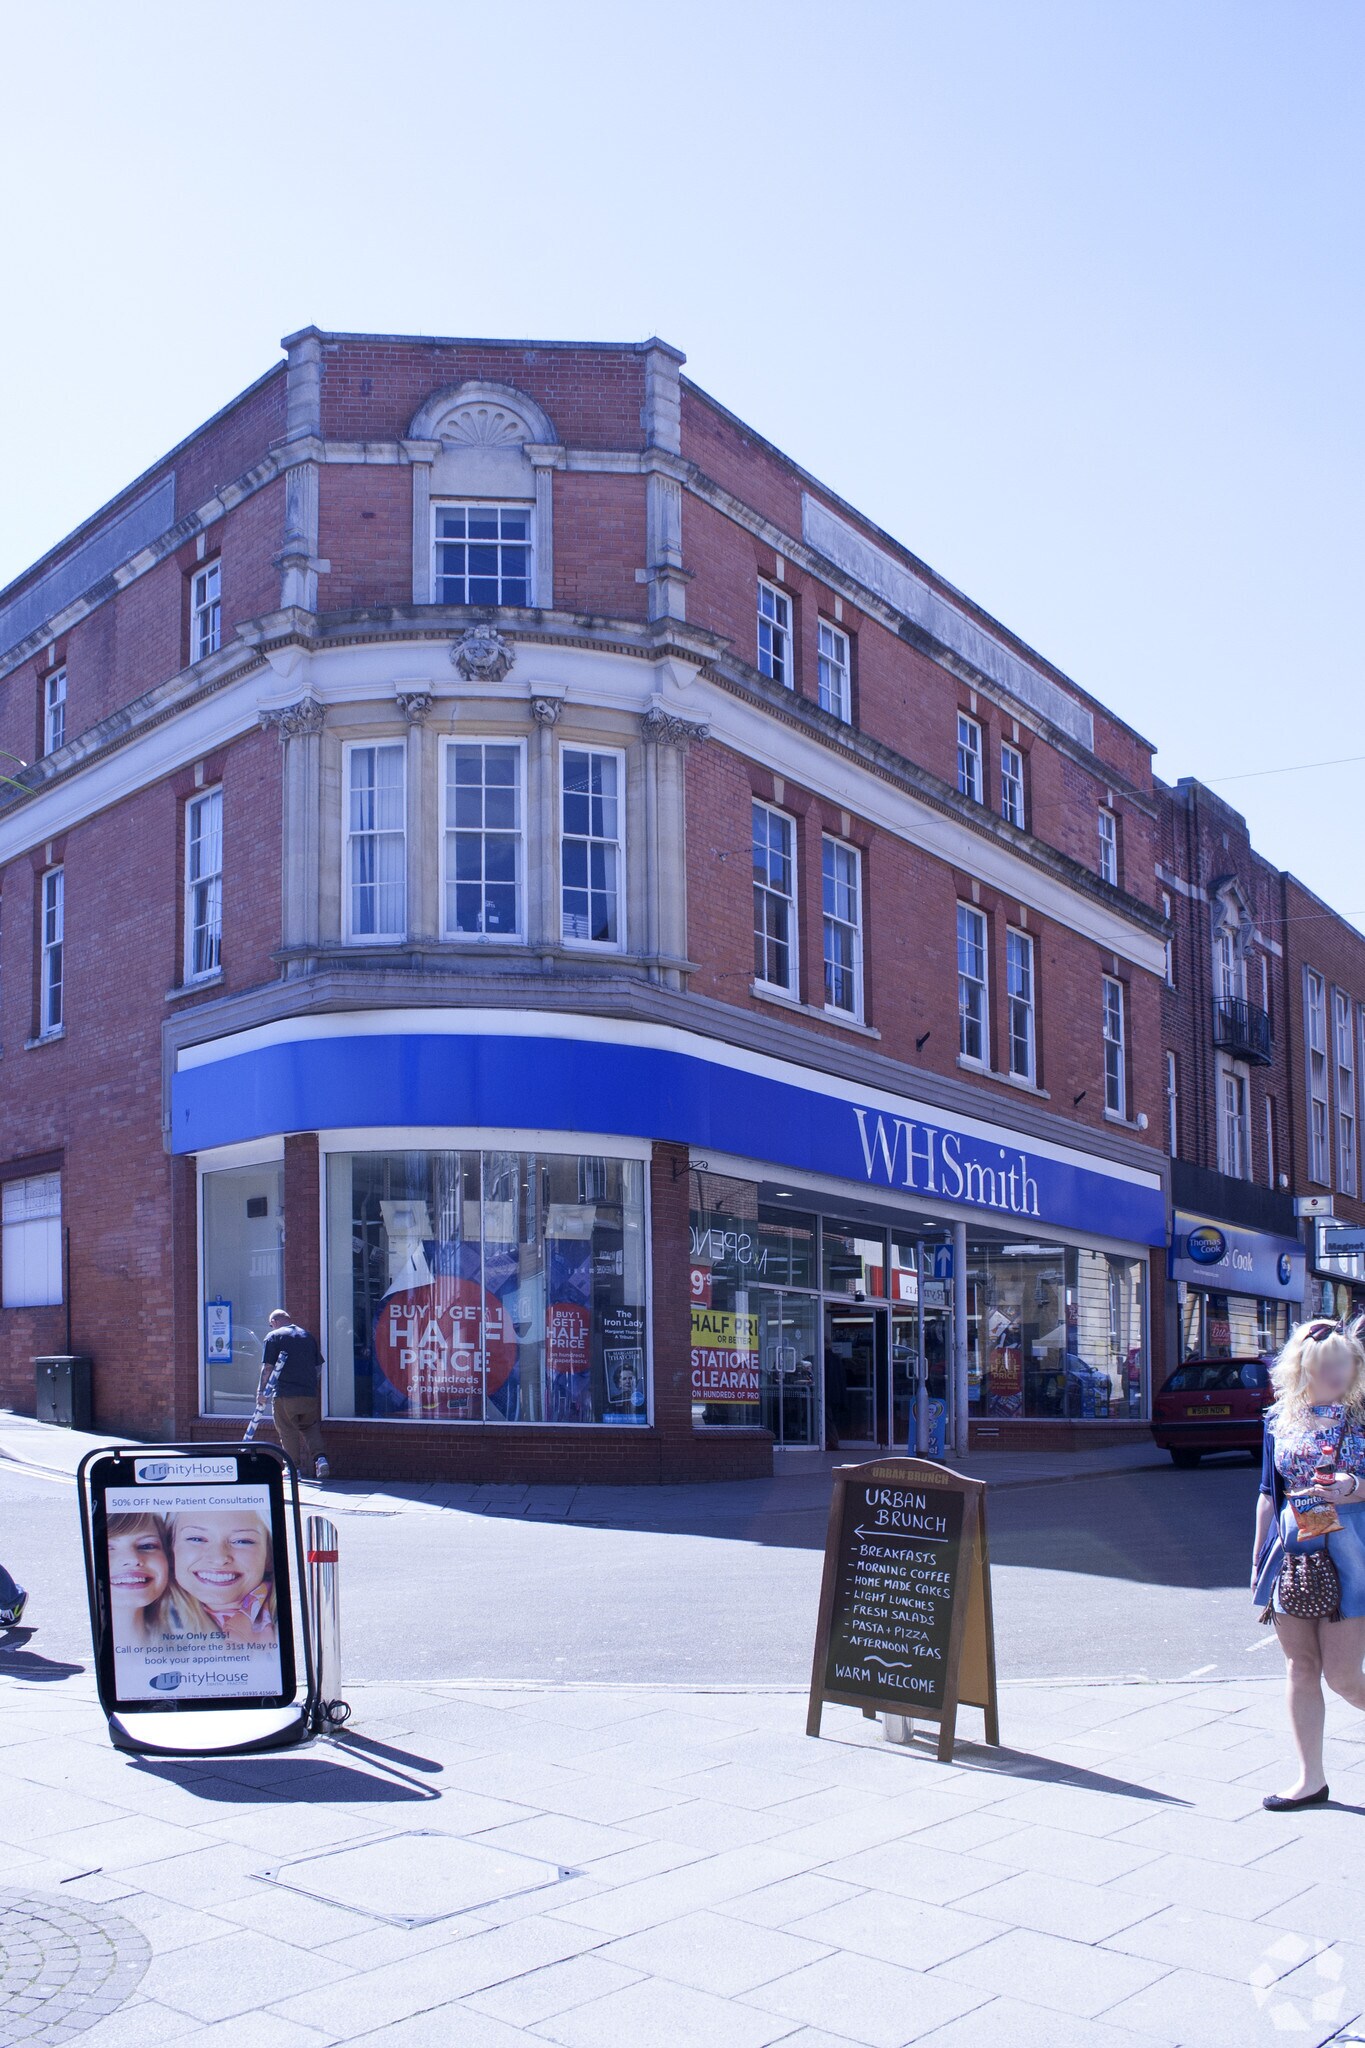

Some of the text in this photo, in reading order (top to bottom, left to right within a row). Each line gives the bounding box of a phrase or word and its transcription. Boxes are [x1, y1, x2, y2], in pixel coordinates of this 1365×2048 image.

[853, 1108, 1040, 1216] WHSmith
[1190, 1239, 1221, 1247] Thomas
[1328, 1242, 1364, 1251] Magnet
[1232, 1249, 1253, 1272] Cook
[390, 1305, 429, 1319] BUY
[434, 1305, 442, 1319] 1
[495, 1307, 503, 1320] 1
[616, 1310, 632, 1319] The
[553, 1319, 575, 1327] GET
[604, 1319, 643, 1329] Iron Lady
[690, 1314, 730, 1334] HALF
[389, 1319, 503, 1350] HALF
[546, 1326, 589, 1339] HALF
[717, 1335, 752, 1345] OR BETTER
[550, 1339, 585, 1349] PRICE
[400, 1350, 491, 1373] PRICE
[690, 1349, 759, 1370] STATIONE
[990, 1364, 1021, 1373] HALF
[993, 1372, 1018, 1380] PRICE
[412, 1374, 479, 1384] on hundreds
[691, 1369, 759, 1389] CLEARAN
[407, 1384, 483, 1395] of paperbacks
[703, 1391, 736, 1399] HUNDREDS
[150, 1463, 234, 1478] TrinityHouse
[872, 1467, 949, 1485] URBAN BRUNCH
[112, 1495, 264, 1507] 50% OFF New Patient Consultation
[865, 1488, 926, 1510] URBAN
[874, 1509, 946, 1533] BRUNCH
[860, 1544, 937, 1566] BREAKFASTS
[857, 1561, 950, 1583] MORNING COFFEE
[854, 1575, 951, 1599] HOME MADE CAKES
[854, 1590, 935, 1612] LIGHT LUNCHES
[853, 1604, 935, 1626] FRESH SALADS
[162, 1632, 230, 1641] Now Only £55!
[852, 1620, 884, 1634] PASTA
[894, 1626, 930, 1642] PIZZA
[115, 1646, 132, 1654] Call
[146, 1647, 163, 1655] pop
[177, 1643, 206, 1652] before
[208, 1643, 223, 1651] the
[247, 1642, 267, 1651] May
[850, 1635, 942, 1660] AFTERNOON TEAS
[145, 1655, 250, 1665] book your appointment
[161, 1671, 249, 1686] TrinityHouse
[835, 1663, 936, 1693] WARM WELCOME
